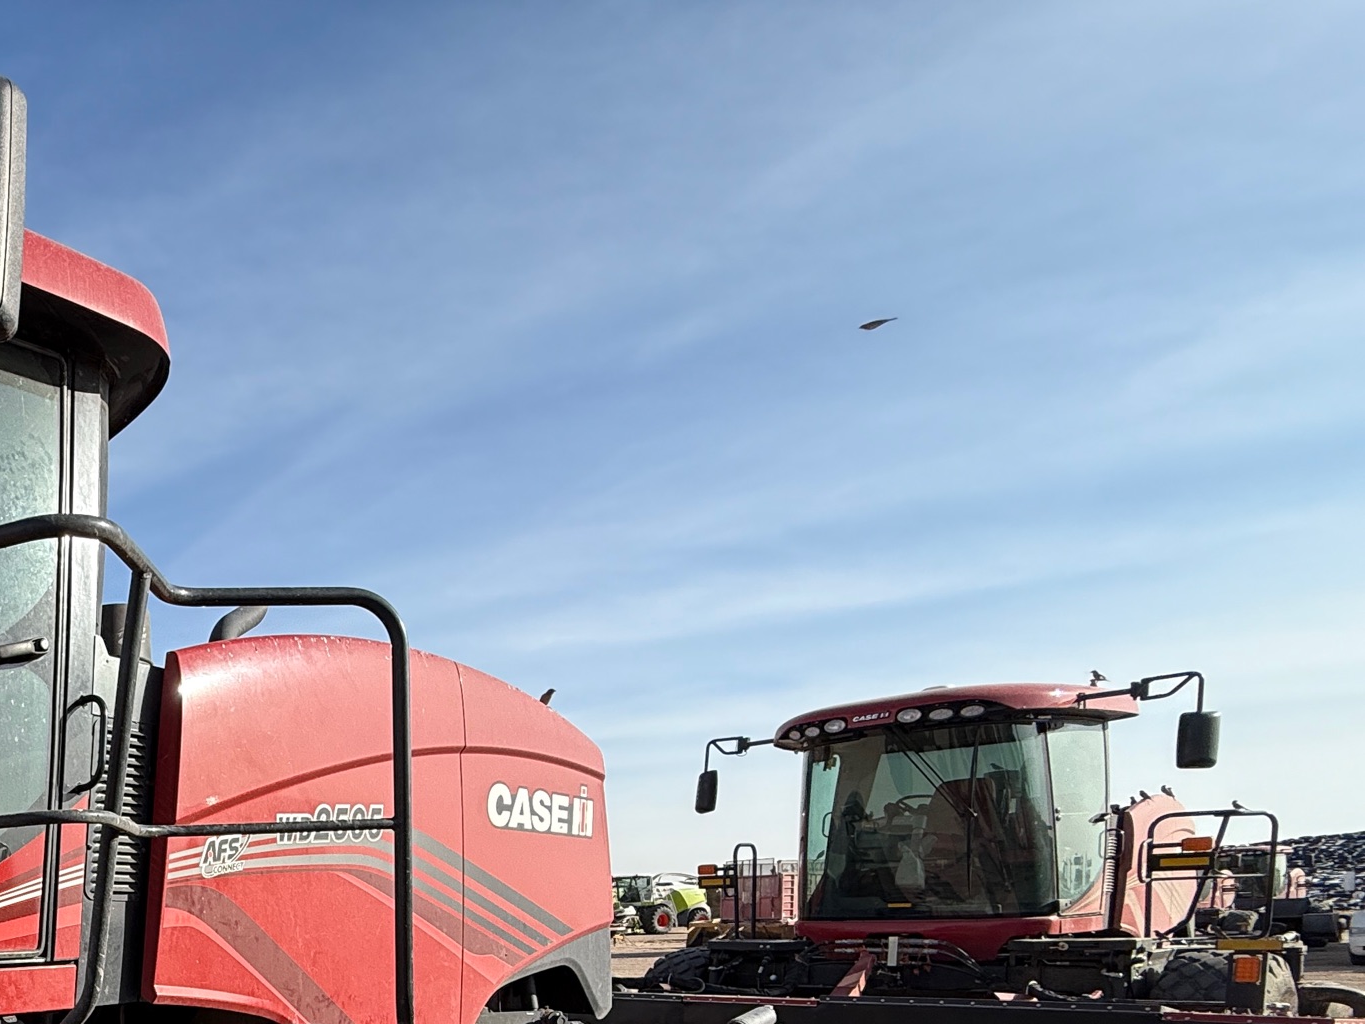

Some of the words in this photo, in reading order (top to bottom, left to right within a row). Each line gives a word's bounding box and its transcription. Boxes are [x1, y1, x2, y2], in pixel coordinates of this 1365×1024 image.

[852, 713, 879, 723] CASE
[486, 781, 570, 834] CASE
[275, 803, 385, 845] WD2505
[202, 837, 241, 865] AFS
[212, 861, 245, 874] CONNECT
